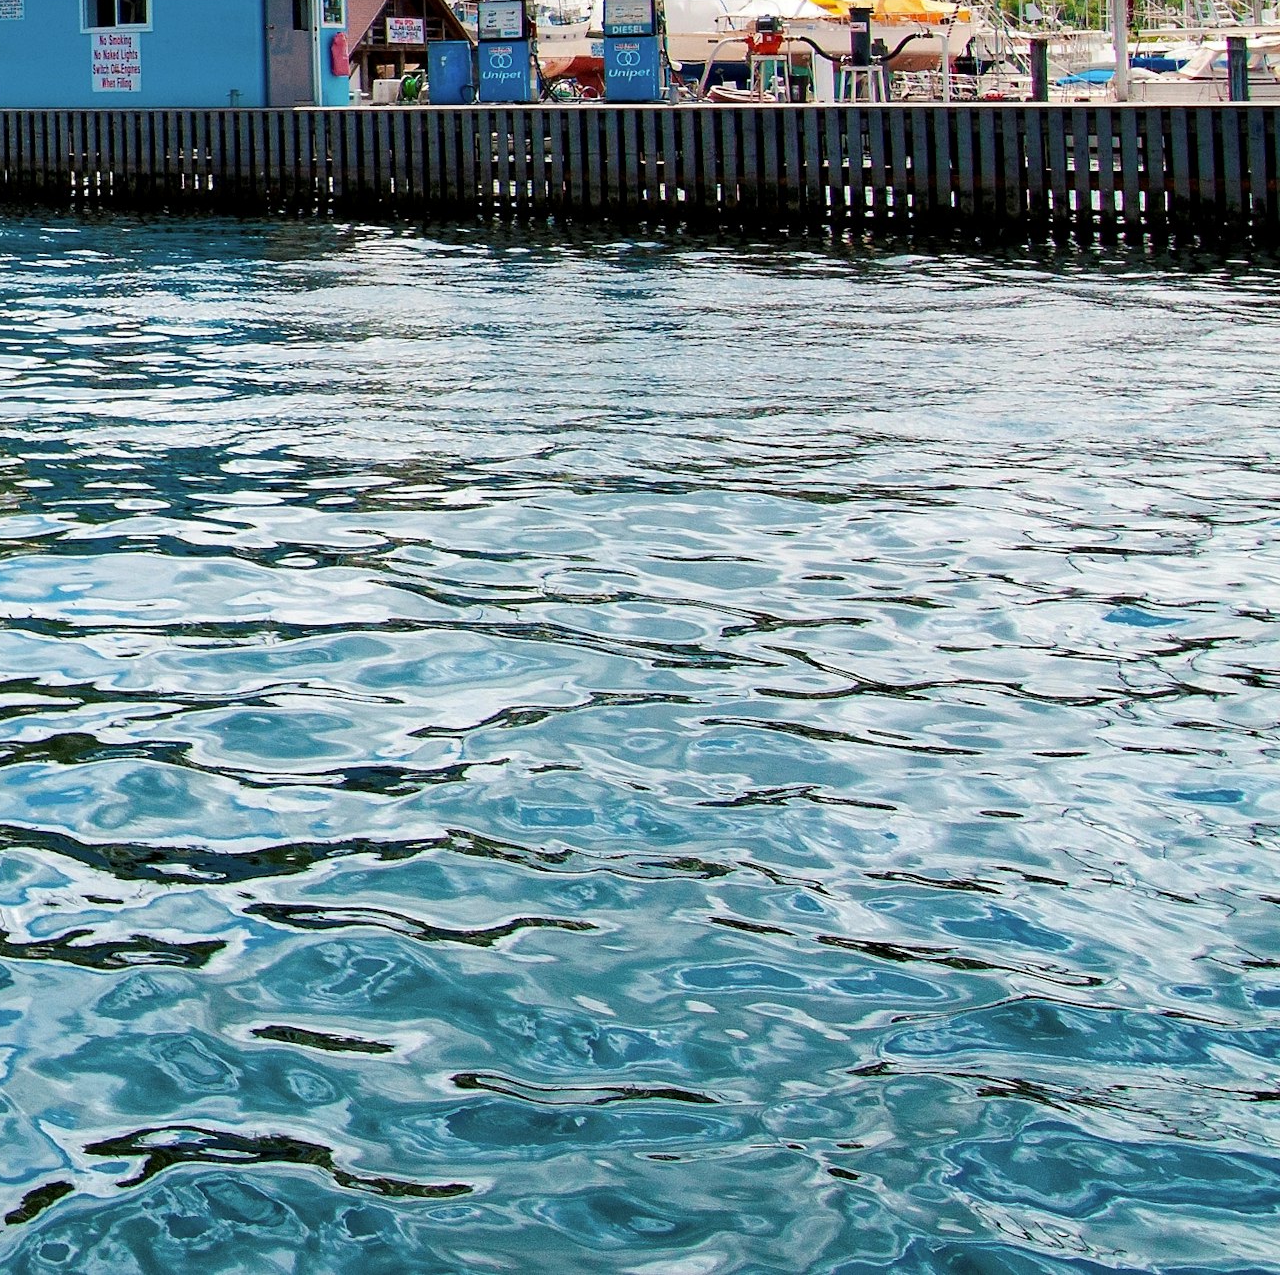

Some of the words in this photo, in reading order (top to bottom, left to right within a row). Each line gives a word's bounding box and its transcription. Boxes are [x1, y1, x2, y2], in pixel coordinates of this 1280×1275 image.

[612, 25, 644, 34] DIESEL
[99, 36, 107, 45] No
[109, 35, 131, 47] Smoking
[94, 50, 101, 60] No
[103, 50, 119, 60] Naked
[121, 49, 137, 62] Lights
[93, 64, 109, 74] Switch
[608, 68, 650, 81] Unipet
[102, 78, 115, 88] When
[117, 77, 131, 90] Filling
[482, 70, 521, 84] Unipet
